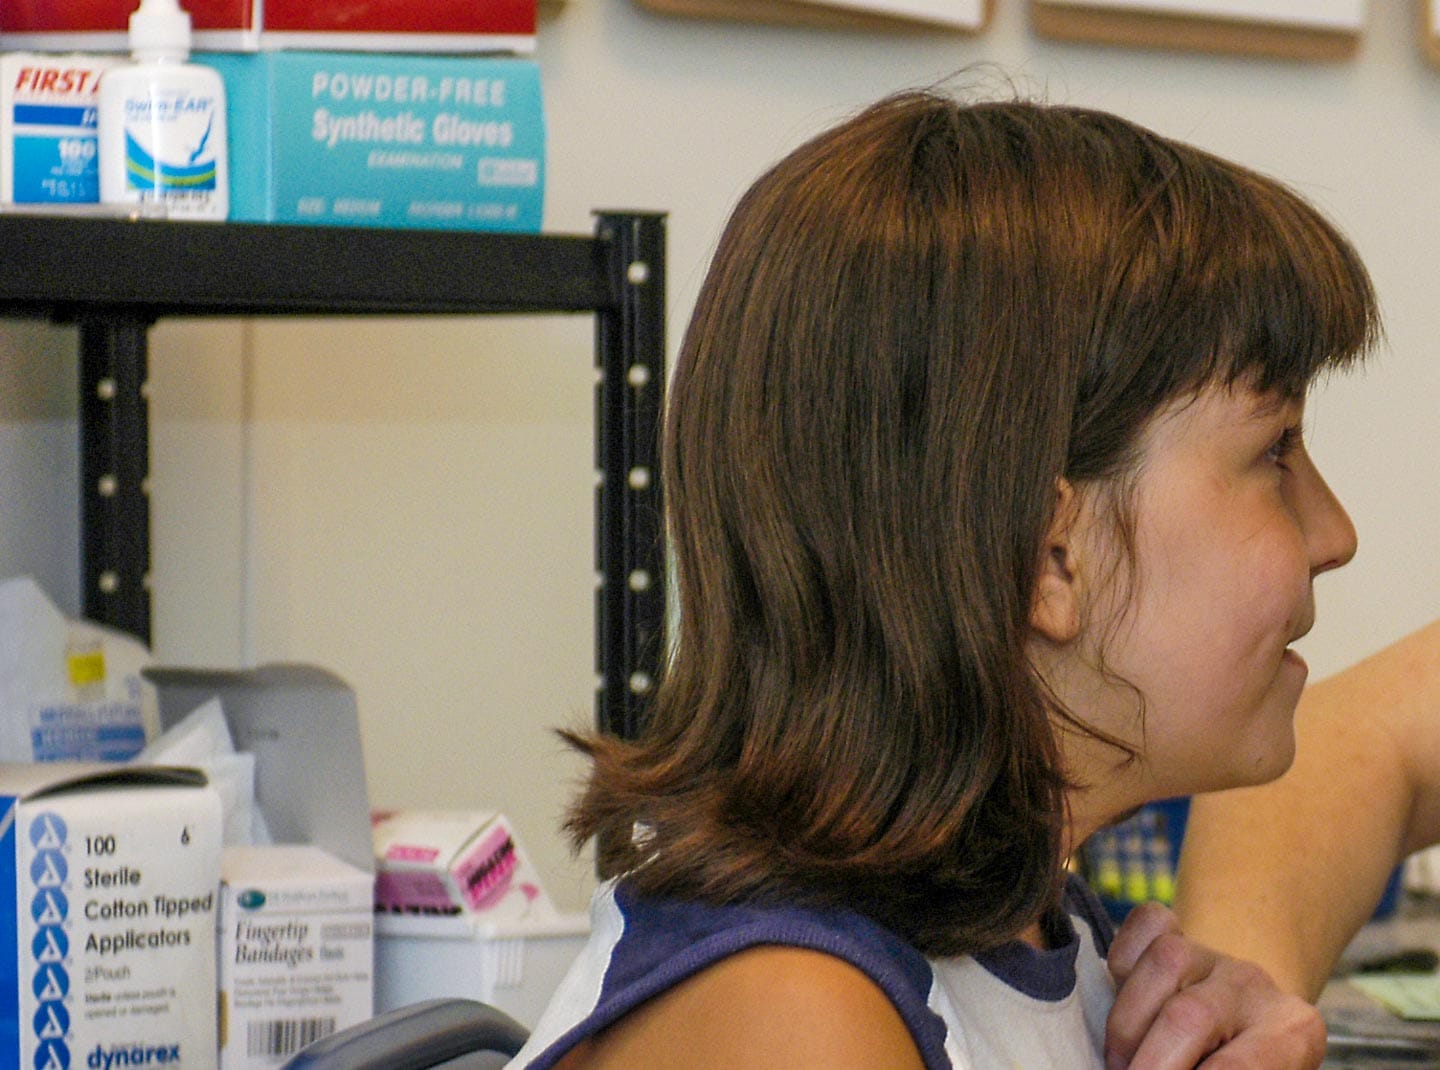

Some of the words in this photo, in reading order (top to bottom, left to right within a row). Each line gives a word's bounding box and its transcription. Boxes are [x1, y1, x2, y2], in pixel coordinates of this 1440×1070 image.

[15, 68, 91, 93] FIRST
[312, 73, 505, 107] POWDER-FREE
[312, 109, 425, 148] Synthetic
[433, 113, 512, 147] Gloves
[86, 834, 116, 856] 100
[84, 866, 142, 889] Sterile
[84, 899, 149, 921] Cotton
[154, 891, 213, 918] Tipped
[84, 928, 191, 955] Applicators
[235, 920, 309, 945] Fingertip
[235, 943, 314, 968] Bandages
[87, 1043, 181, 1070] dynarex
